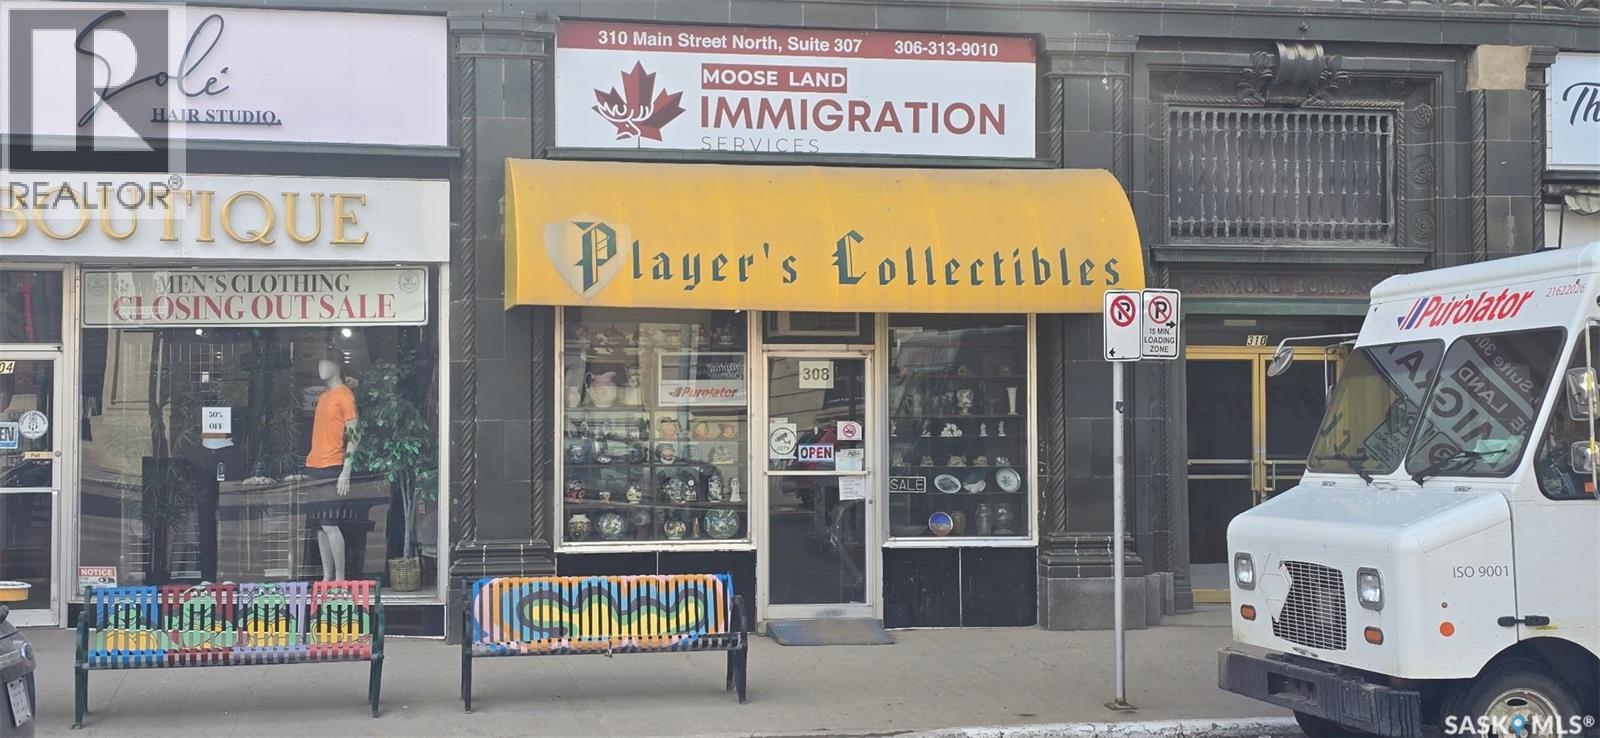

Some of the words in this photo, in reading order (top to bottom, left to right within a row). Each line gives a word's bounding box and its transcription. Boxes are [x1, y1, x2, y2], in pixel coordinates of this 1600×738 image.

[599, 30, 628, 44] 310
[633, 32, 672, 46] Main
[678, 32, 727, 48] Street
[732, 35, 782, 53] North,
[788, 36, 829, 51] Suite
[834, 38, 863, 53] 307
[895, 40, 998, 57] 306-313-9010
[703, 69, 778, 86] MOOSE
[789, 72, 846, 88] LAND
[151, 107, 200, 123] HAIR
[701, 95, 1006, 136] IMMIGRATION
[701, 136, 820, 153] SERVICES
[575, 219, 799, 296] Player's
[831, 229, 1122, 287] Collectibles
[157, 274, 228, 294] MEN’S
[231, 273, 350, 294] CLOTHING
[113, 295, 246, 322] CLOSING
[251, 294, 315, 320] OUT
[319, 293, 396, 320] SALE
[1414, 287, 1535, 330] Purolator
[1144, 336, 1175, 344] LOADING
[1248, 335, 1267, 346] 310
[1149, 345, 1169, 353] ZONE
[803, 367, 830, 381] 308
[681, 386, 738, 398] Purolator
[800, 446, 832, 459] OPEN
[890, 479, 923, 491] SALE
[80, 568, 113, 576] NOTICE
[1453, 567, 1475, 578] ISO
[1478, 566, 1509, 577] 9001
